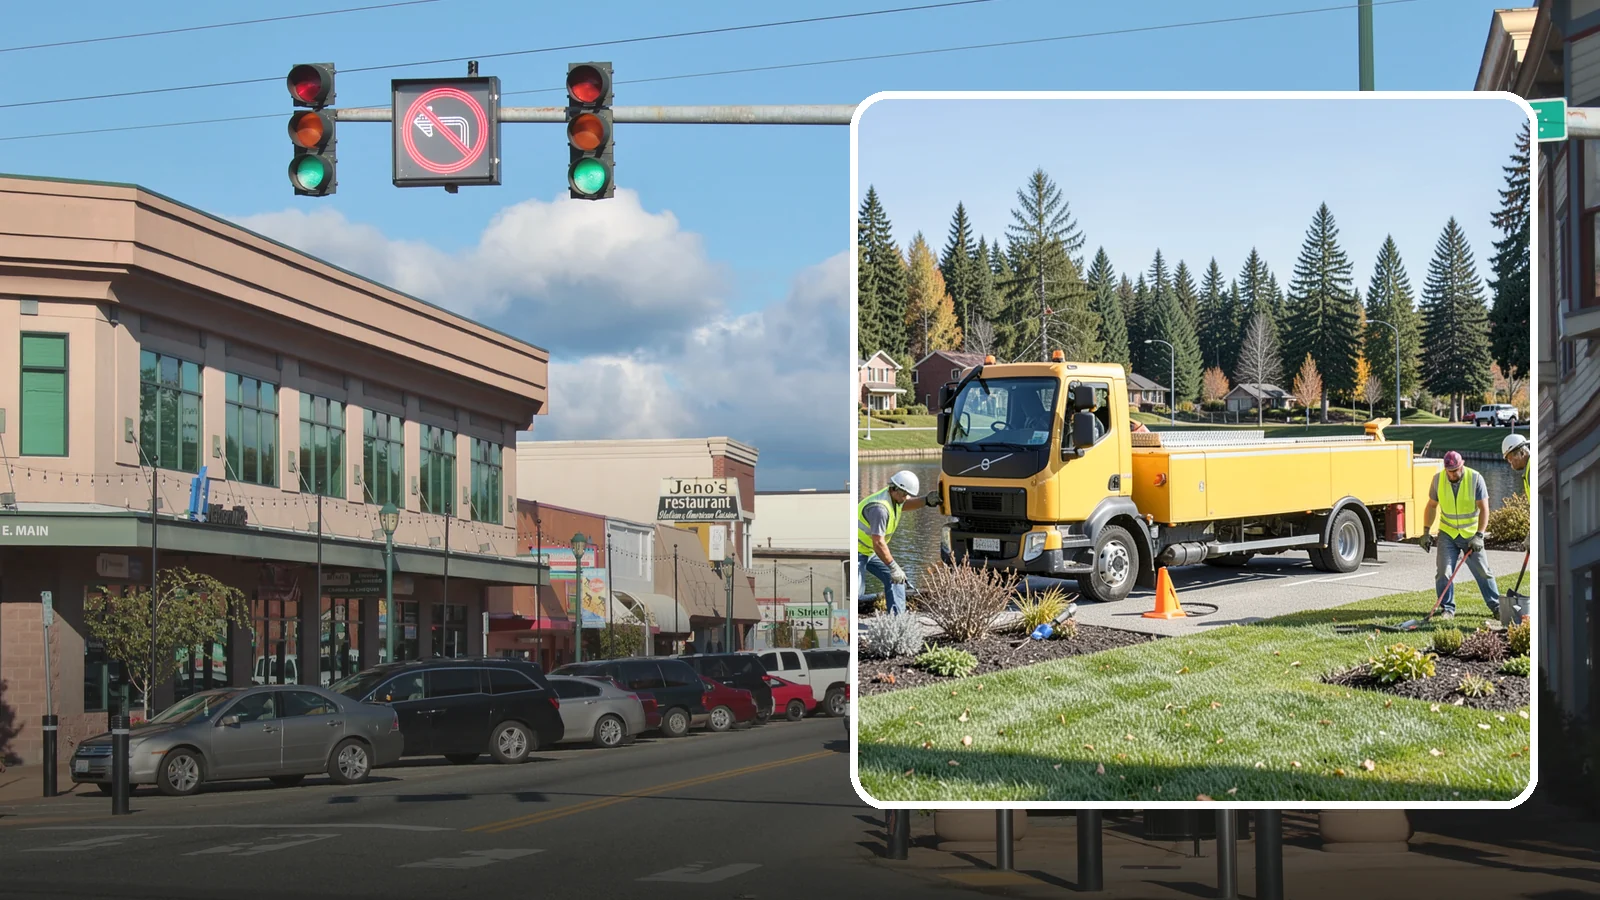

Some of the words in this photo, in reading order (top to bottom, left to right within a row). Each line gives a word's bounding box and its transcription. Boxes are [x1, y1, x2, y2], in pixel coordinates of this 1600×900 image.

[670, 480, 727, 494] Jeno's
[665, 496, 731, 509] restaurant
[659, 510, 682, 520] Italian
[686, 510, 714, 520] American
[715, 509, 737, 519] Cuisine
[2, 525, 13, 536] E.
[16, 525, 49, 536] MAIN
[797, 607, 828, 617] Street
[791, 619, 823, 627] lass
